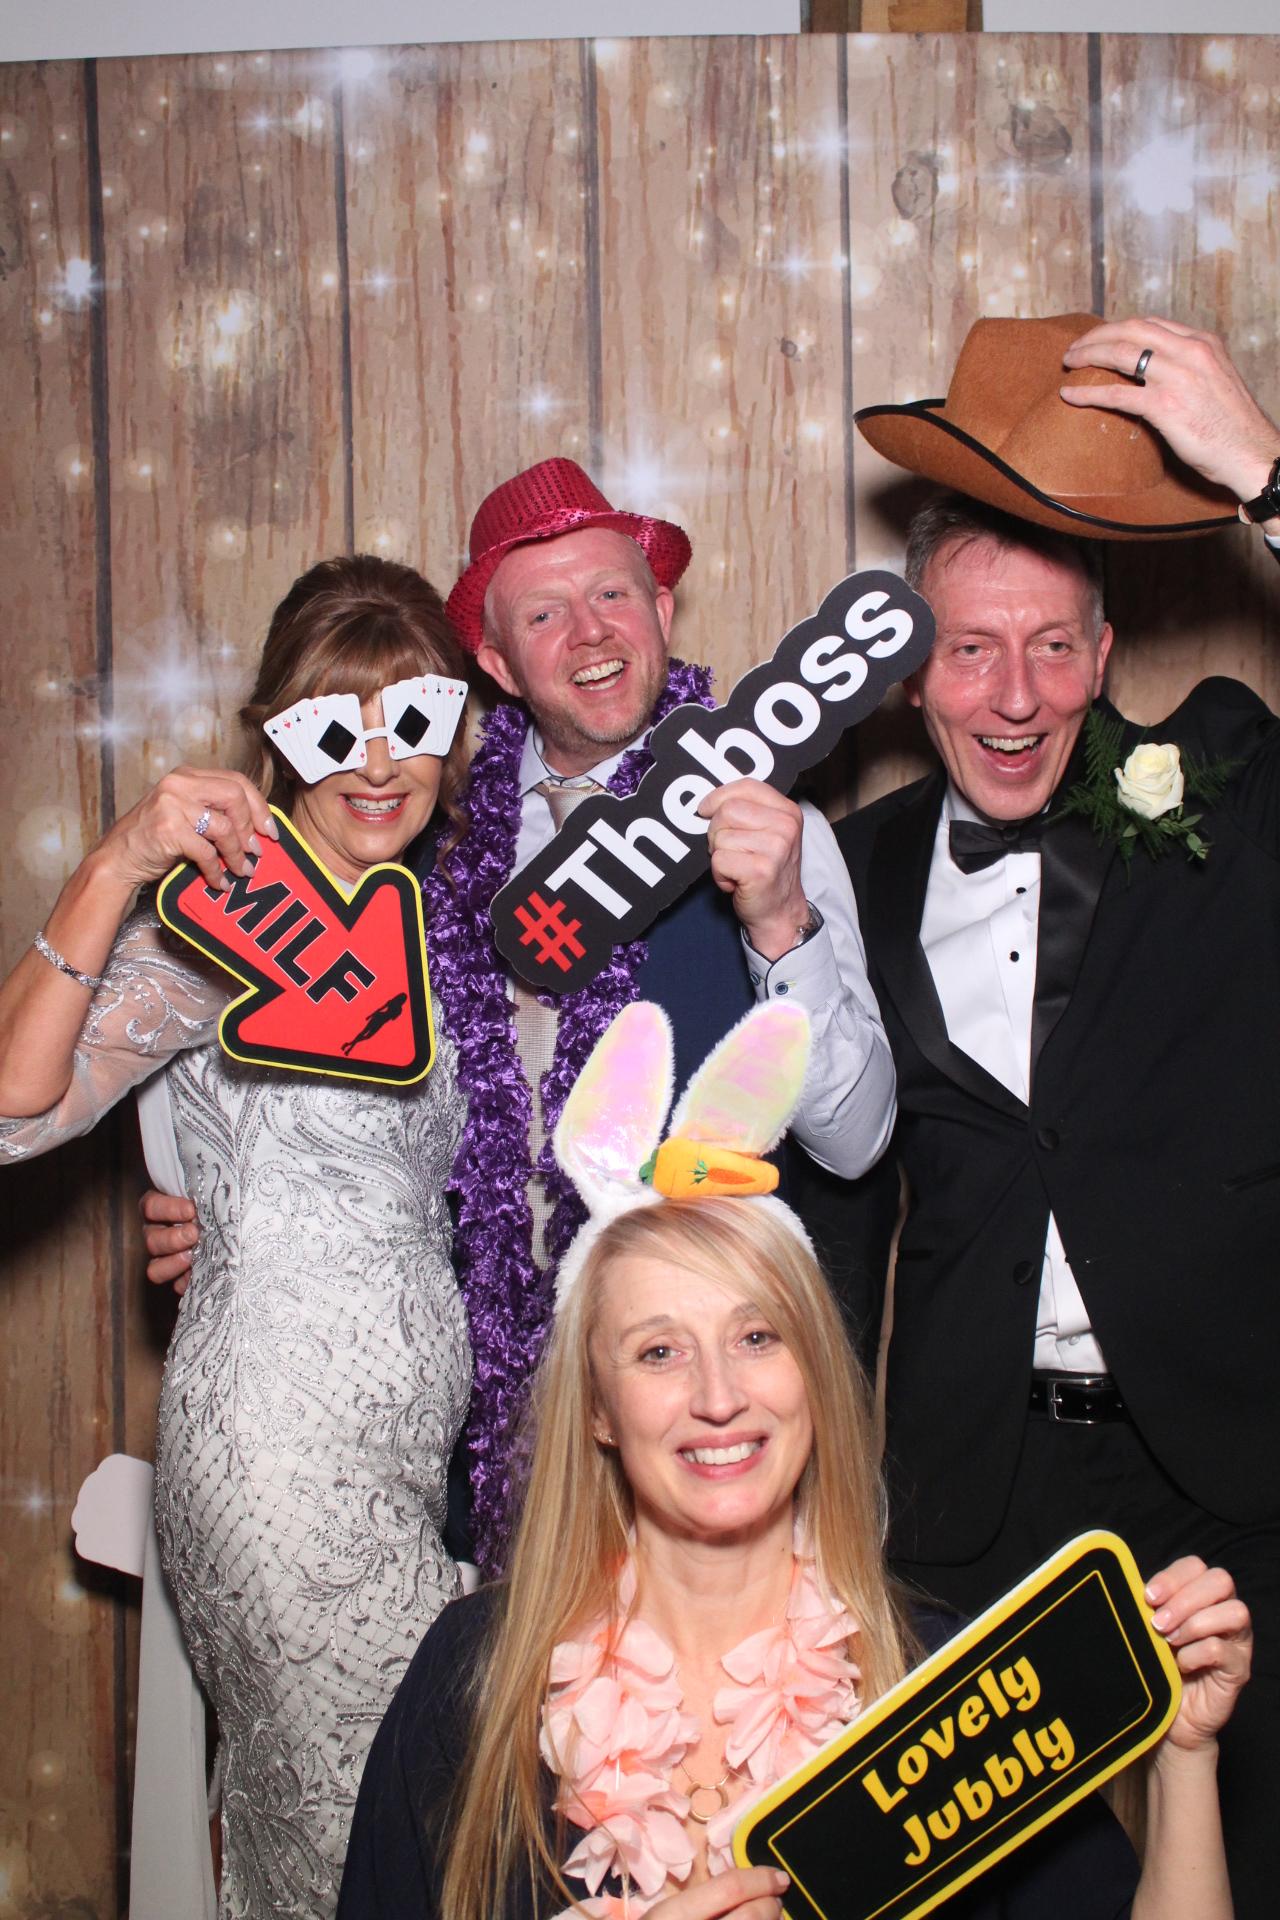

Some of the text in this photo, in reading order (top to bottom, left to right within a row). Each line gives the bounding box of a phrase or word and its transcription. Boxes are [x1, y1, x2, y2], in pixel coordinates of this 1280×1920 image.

[514, 590, 914, 973] #Theboss
[203, 855, 376, 1004] MILF
[861, 1656, 1041, 1814] Lovely
[903, 1716, 1075, 1866] Jubbly
